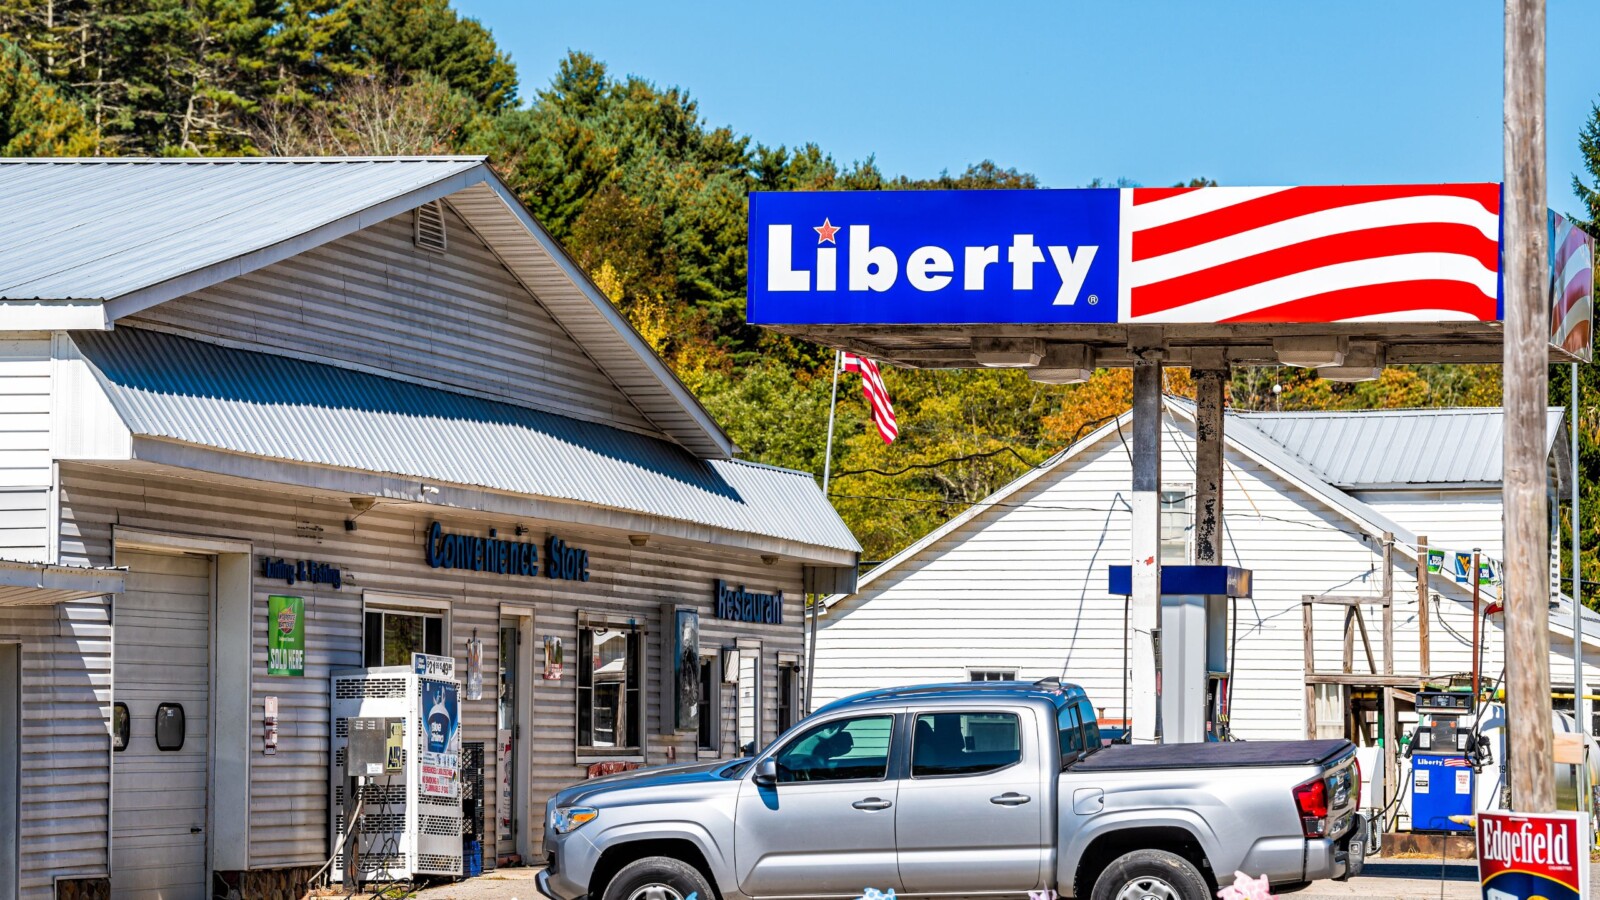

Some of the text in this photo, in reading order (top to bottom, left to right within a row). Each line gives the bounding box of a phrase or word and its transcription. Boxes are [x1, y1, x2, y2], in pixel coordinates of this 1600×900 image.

[767, 218, 1099, 306] Liberty
[427, 521, 590, 582] Convenience Store
[714, 579, 784, 625] Restaurant
[271, 648, 303, 669] SOLD HERE
[387, 746, 401, 768] AIR
[1482, 819, 1570, 868] Edgefield
